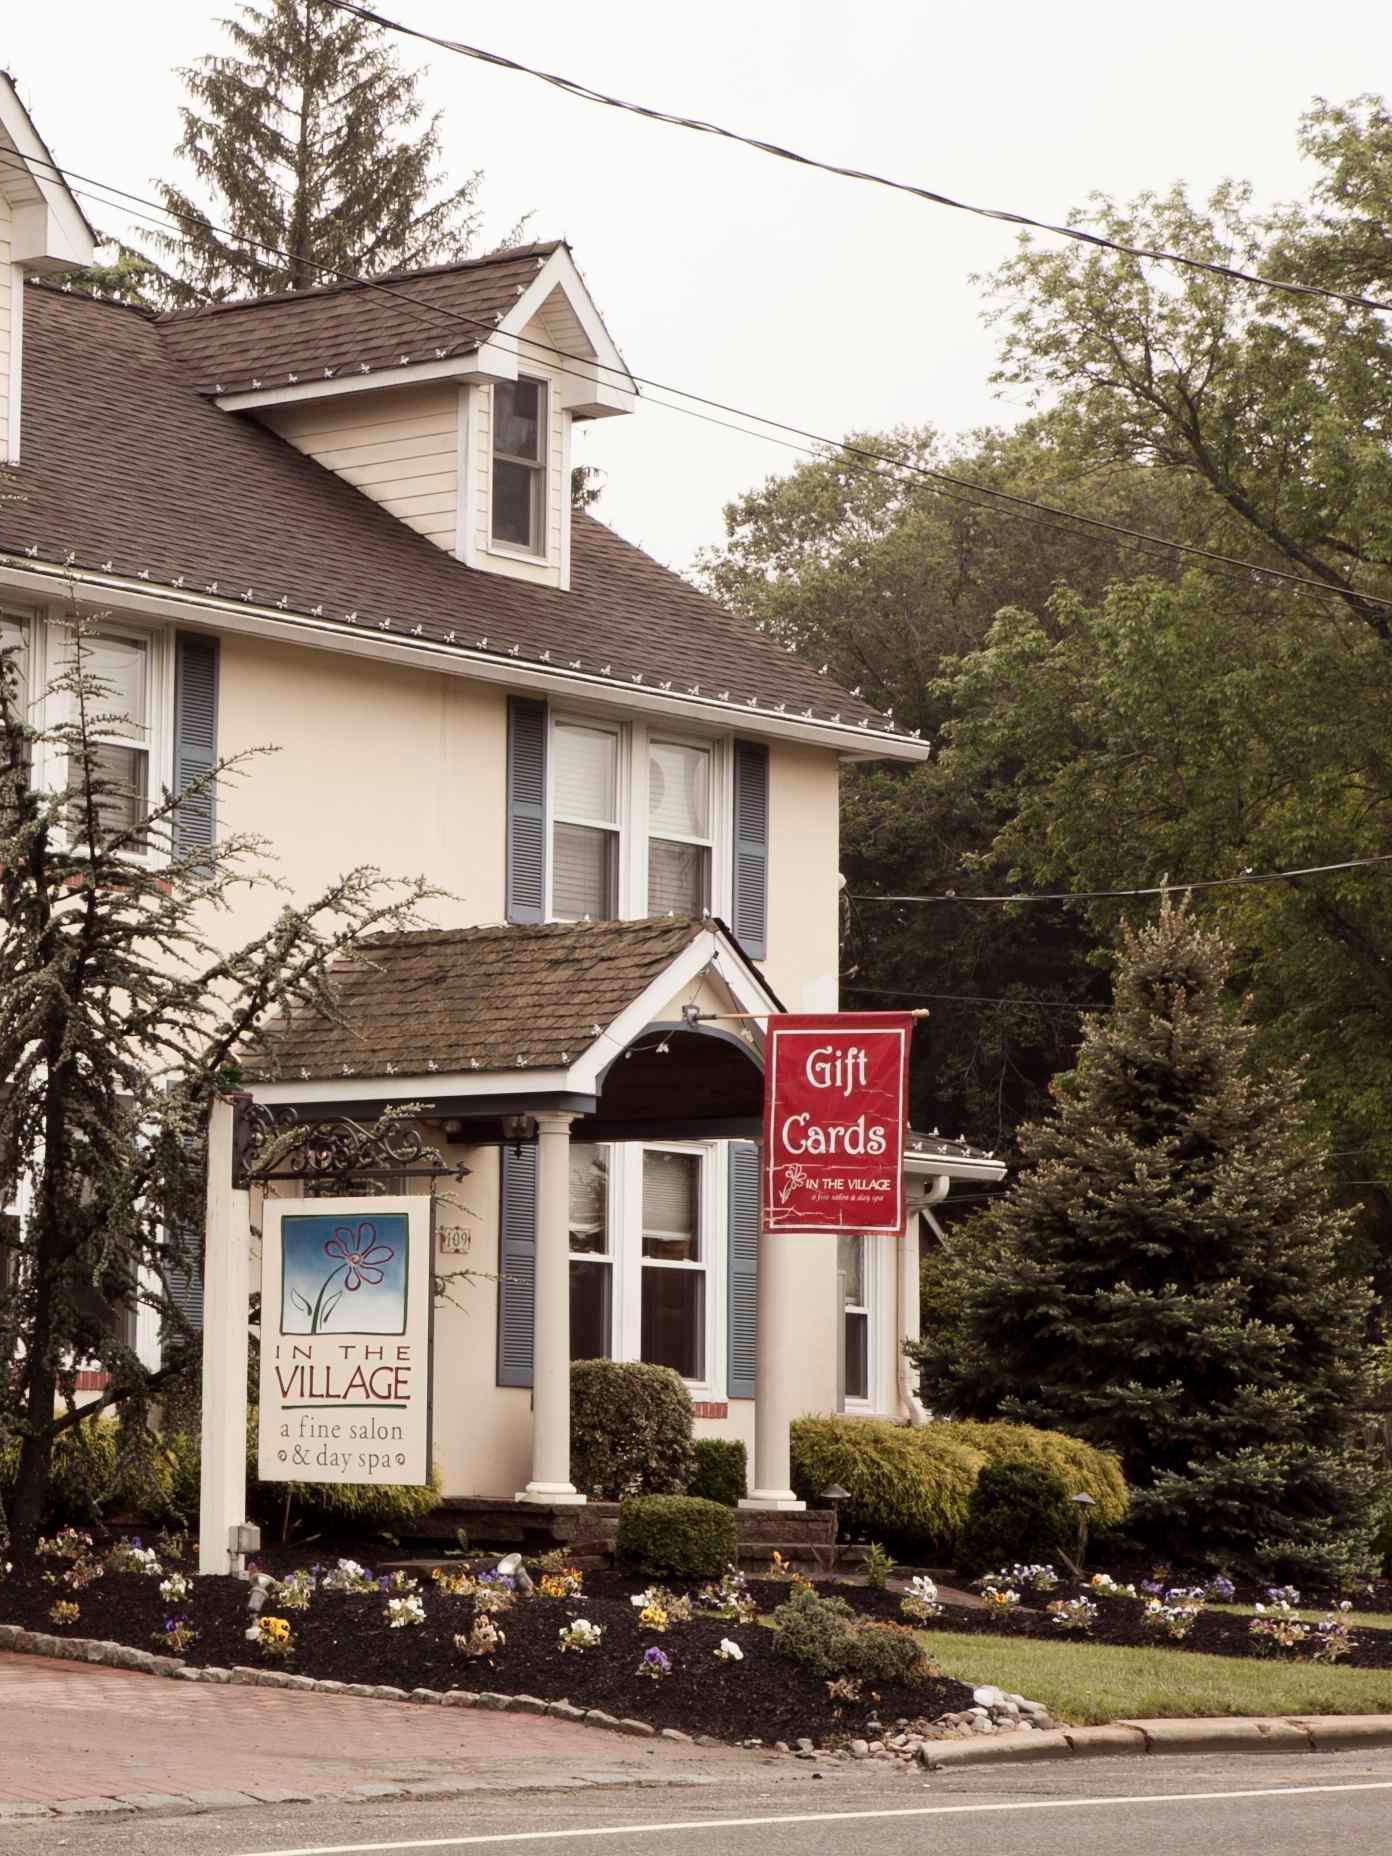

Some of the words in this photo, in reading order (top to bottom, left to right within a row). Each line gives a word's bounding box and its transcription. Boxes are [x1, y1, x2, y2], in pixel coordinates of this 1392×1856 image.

[805, 1045, 868, 1097] Gift
[781, 1112, 886, 1155] Cards
[805, 1178, 819, 1190] IN
[822, 1178, 845, 1190] THE
[848, 1178, 891, 1191] VILLAGE
[275, 1345, 312, 1360] IN
[338, 1345, 411, 1361] THE
[275, 1364, 411, 1400] VILLAGE
[280, 1422, 290, 1438] a
[299, 1415, 341, 1439] fine
[349, 1416, 404, 1440] salon
[292, 1443, 312, 1466] &
[316, 1443, 352, 1474] day
[358, 1451, 391, 1475] spa
